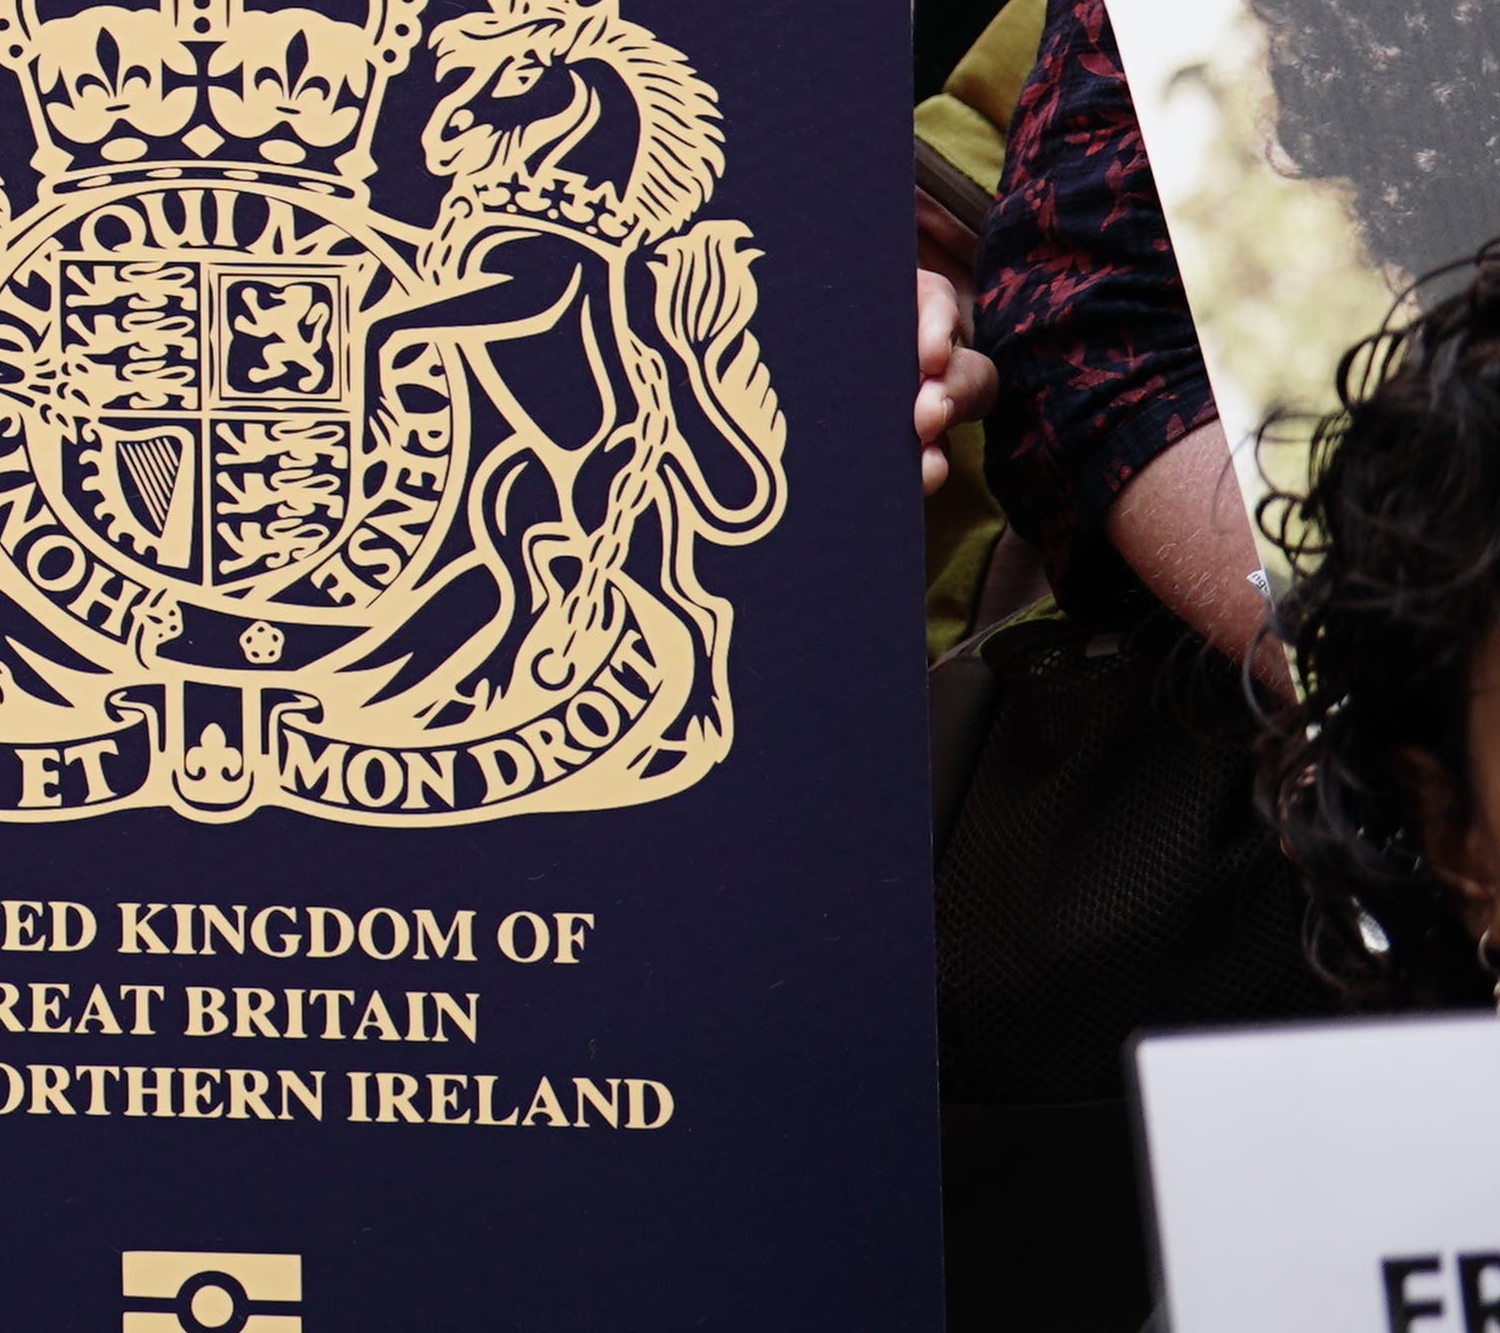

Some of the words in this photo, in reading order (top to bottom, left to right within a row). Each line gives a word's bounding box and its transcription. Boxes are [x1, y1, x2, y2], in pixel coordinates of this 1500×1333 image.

[17, 741, 119, 807] ET
[282, 733, 452, 810] MON
[467, 632, 655, 798] DROIT
[117, 902, 478, 962] KINGDOM
[496, 910, 595, 965] OF
[183, 985, 479, 1045] BRITAIN
[346, 1071, 675, 1131] IRELAND
